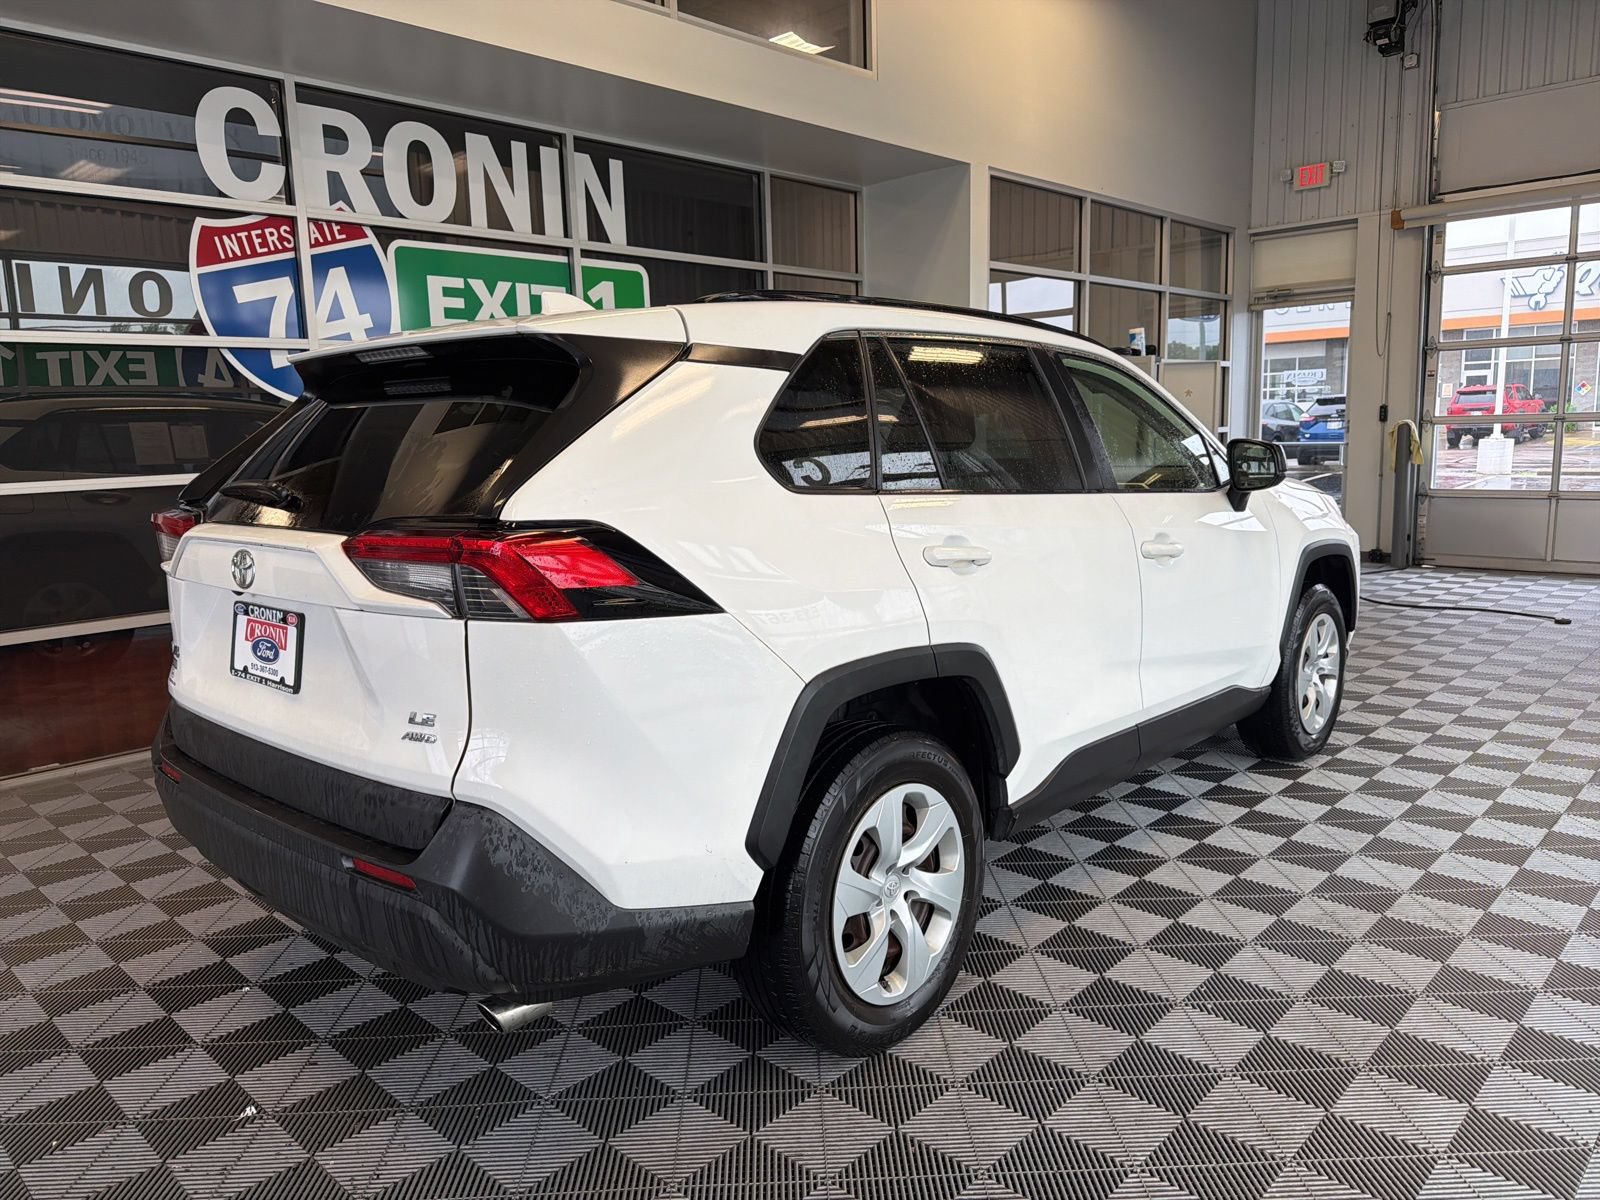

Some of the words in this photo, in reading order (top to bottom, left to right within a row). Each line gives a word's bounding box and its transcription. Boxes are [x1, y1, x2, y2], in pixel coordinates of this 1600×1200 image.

[195, 86, 627, 247] CRONIN
[1299, 163, 1326, 187] EXIT
[214, 221, 347, 260] INTERSATE
[427, 275, 568, 328] EXIT
[587, 280, 616, 311] 1
[232, 266, 374, 370] 74
[248, 605, 284, 624] CRONIN
[247, 621, 287, 650] CRONIN
[256, 640, 275, 660] Ford
[408, 711, 437, 727] LE
[401, 731, 437, 744] AWD
